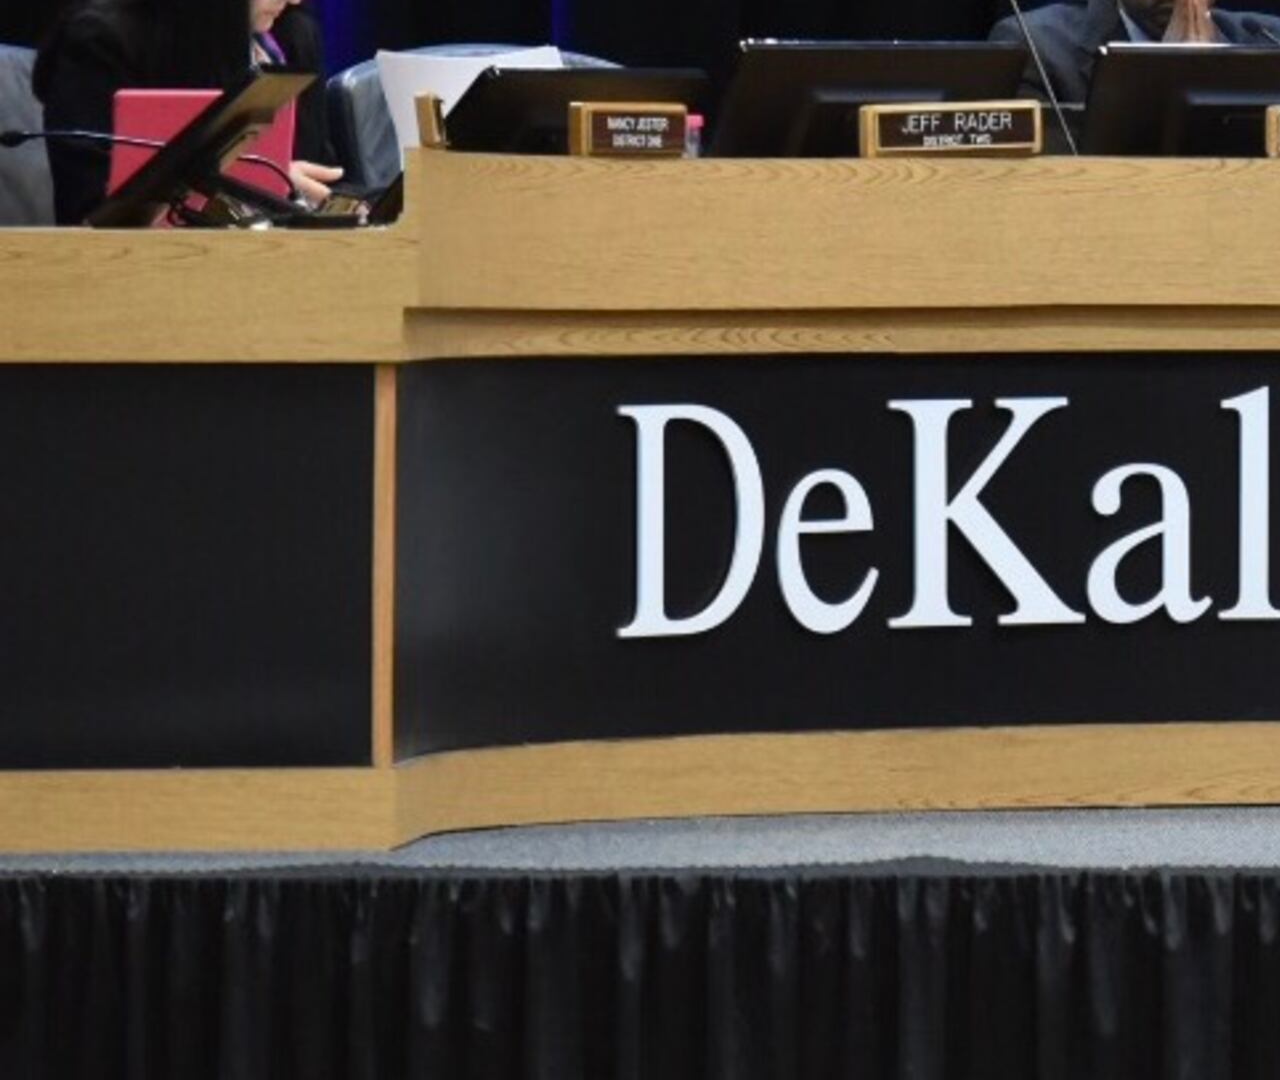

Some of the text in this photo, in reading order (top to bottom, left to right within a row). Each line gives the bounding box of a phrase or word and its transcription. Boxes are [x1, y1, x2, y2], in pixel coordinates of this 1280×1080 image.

[902, 112, 1012, 133] JEFF RADER
[923, 134, 993, 147] DISTRICT TWO
